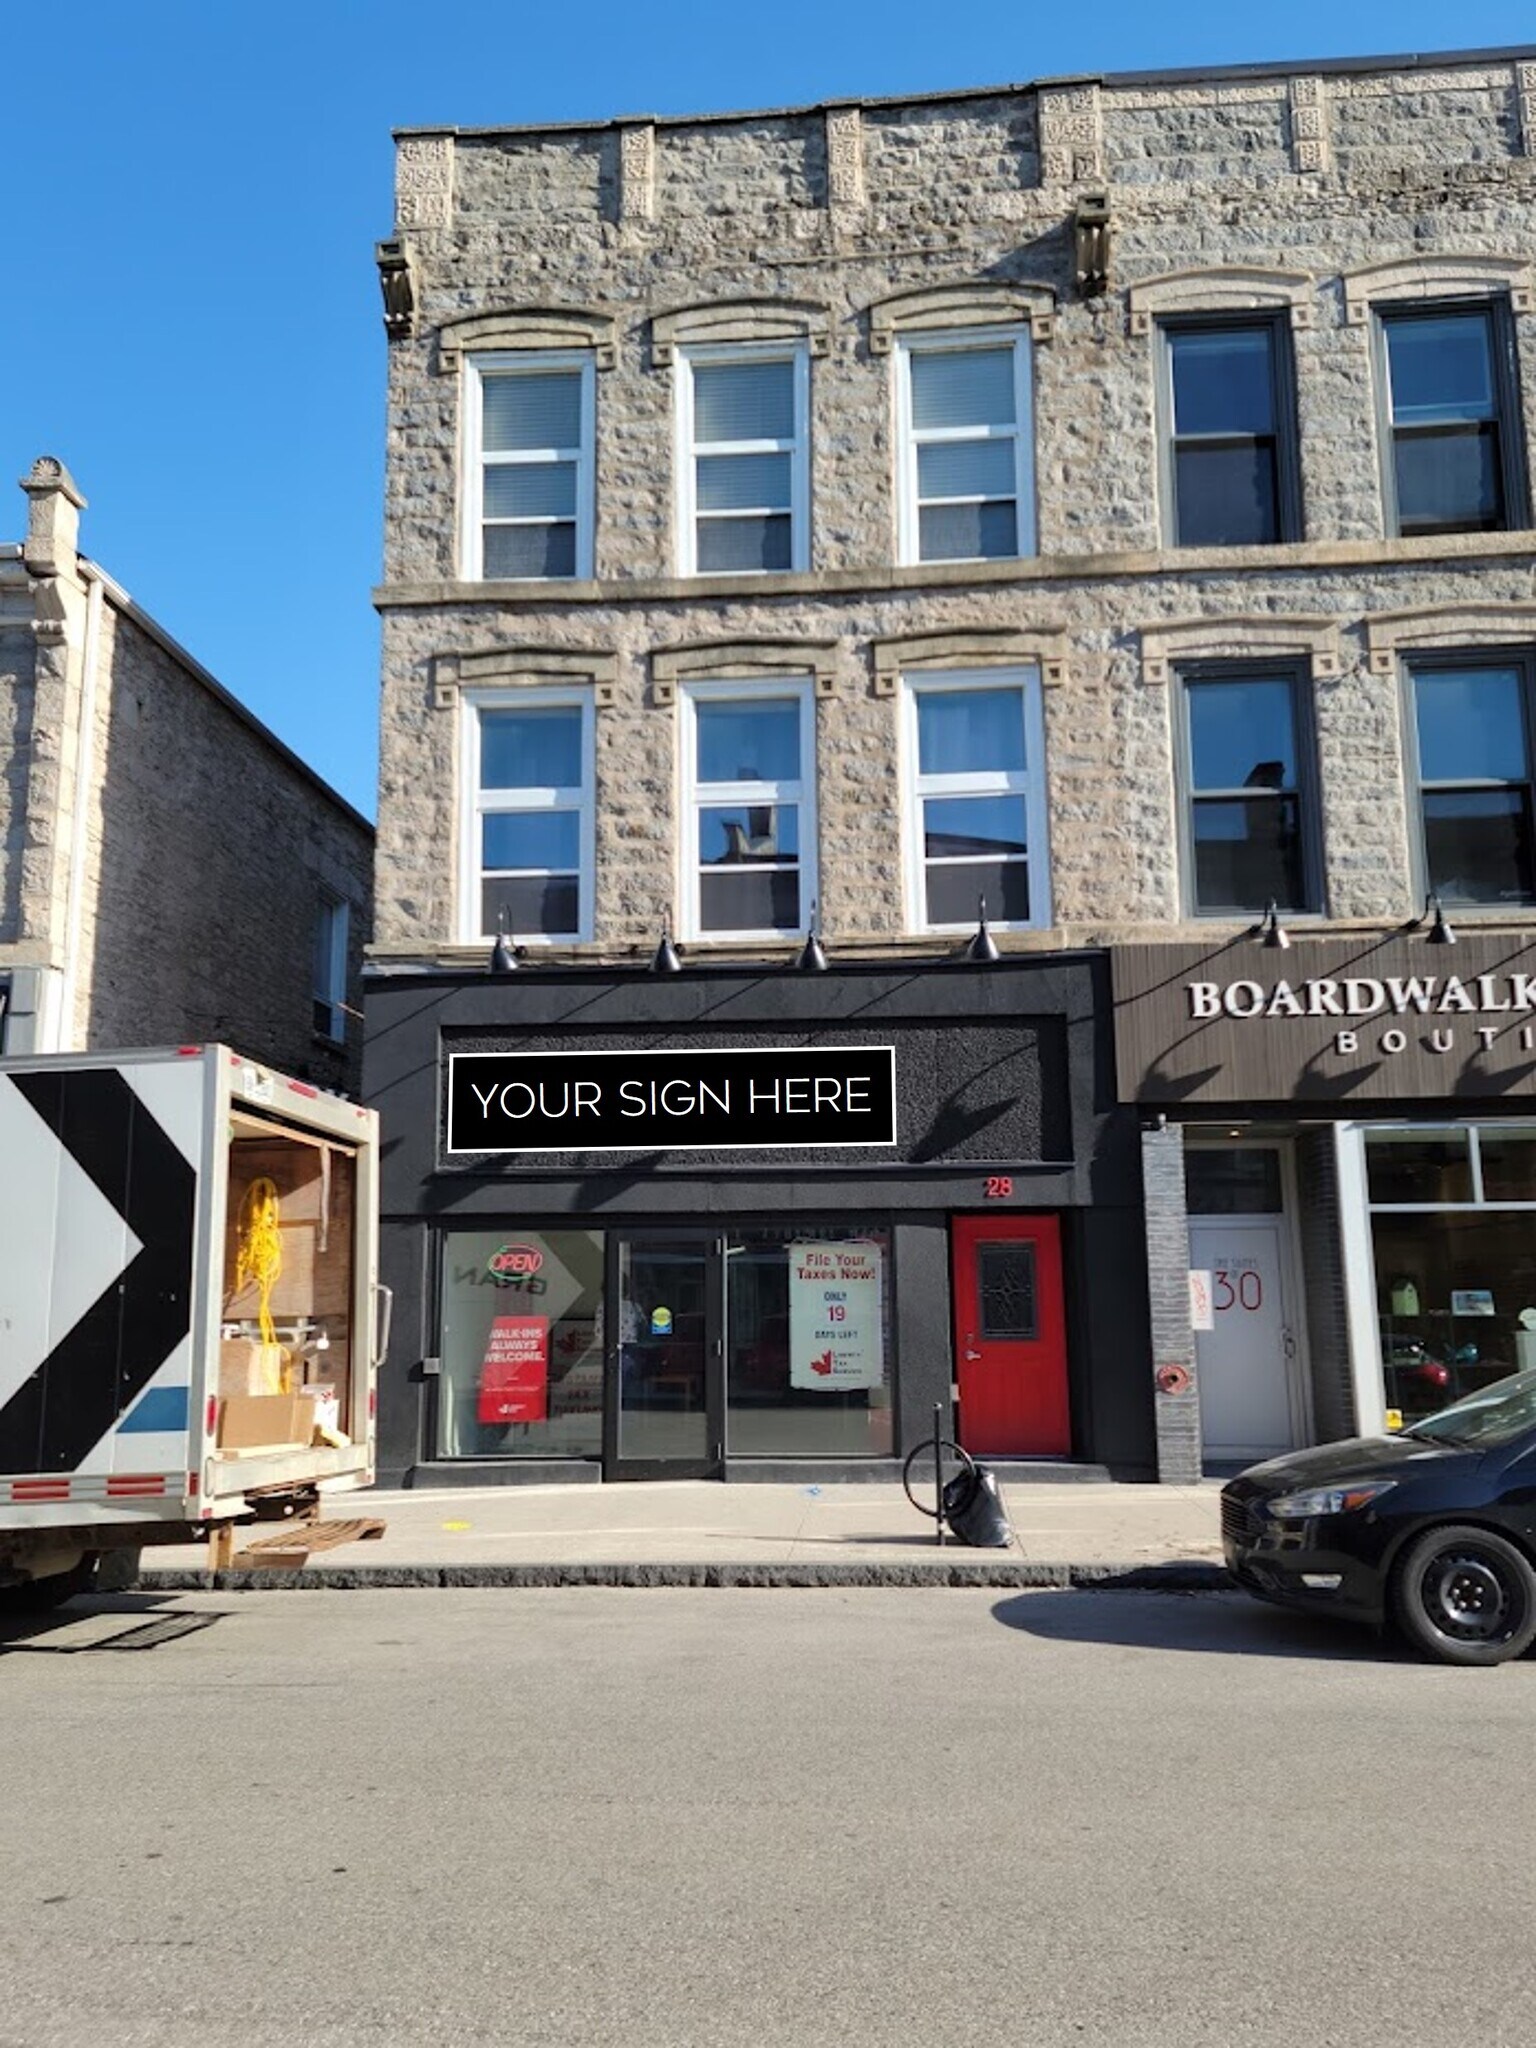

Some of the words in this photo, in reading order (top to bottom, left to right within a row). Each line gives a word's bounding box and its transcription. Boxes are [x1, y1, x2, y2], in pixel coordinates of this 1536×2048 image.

[1189, 974, 1536, 1018] BOARDWALK
[471, 1082, 601, 1119] YOUR
[619, 1079, 730, 1117] SIGN
[748, 1077, 871, 1114] HERE
[988, 1177, 1012, 1196] 28
[493, 1253, 539, 1271] OPEN
[805, 1254, 831, 1266] File
[836, 1254, 866, 1266] Your
[797, 1268, 836, 1280] Taxes
[841, 1268, 876, 1280] Now!
[1215, 1271, 1262, 1311] 30
[828, 1305, 846, 1321] 19
